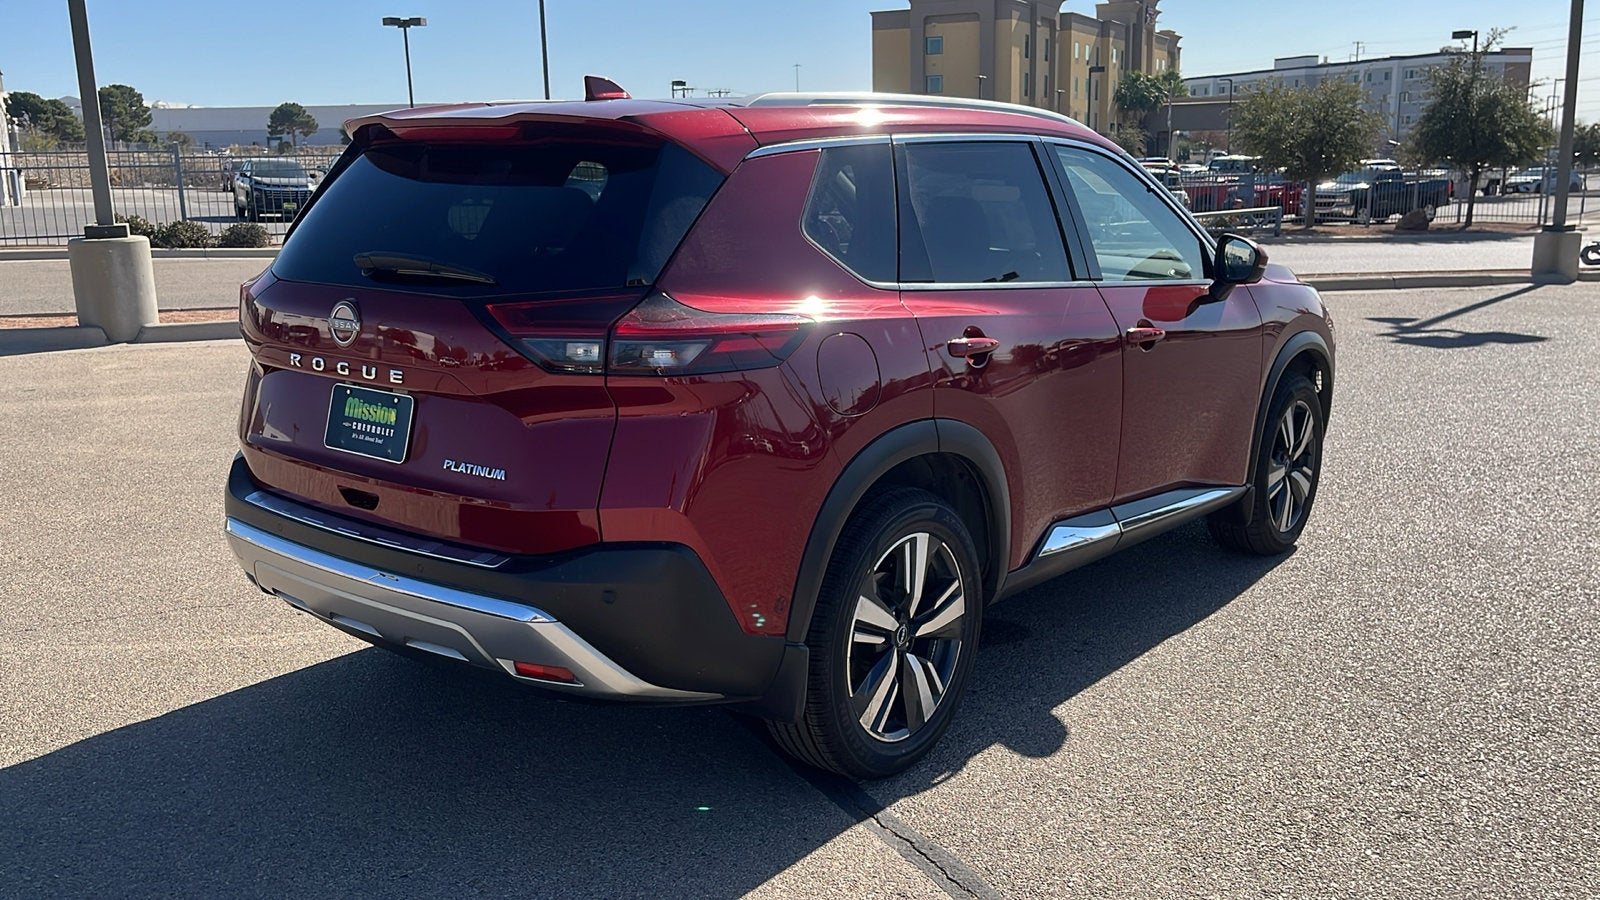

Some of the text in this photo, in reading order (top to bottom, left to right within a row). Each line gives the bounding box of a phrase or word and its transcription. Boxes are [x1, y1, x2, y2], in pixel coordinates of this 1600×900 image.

[328, 318, 360, 331] NSSAN
[290, 352, 403, 384] ROGUE
[344, 396, 397, 426] Mission
[352, 421, 395, 437] CHEVROLET
[443, 459, 506, 481] PLATINUM
